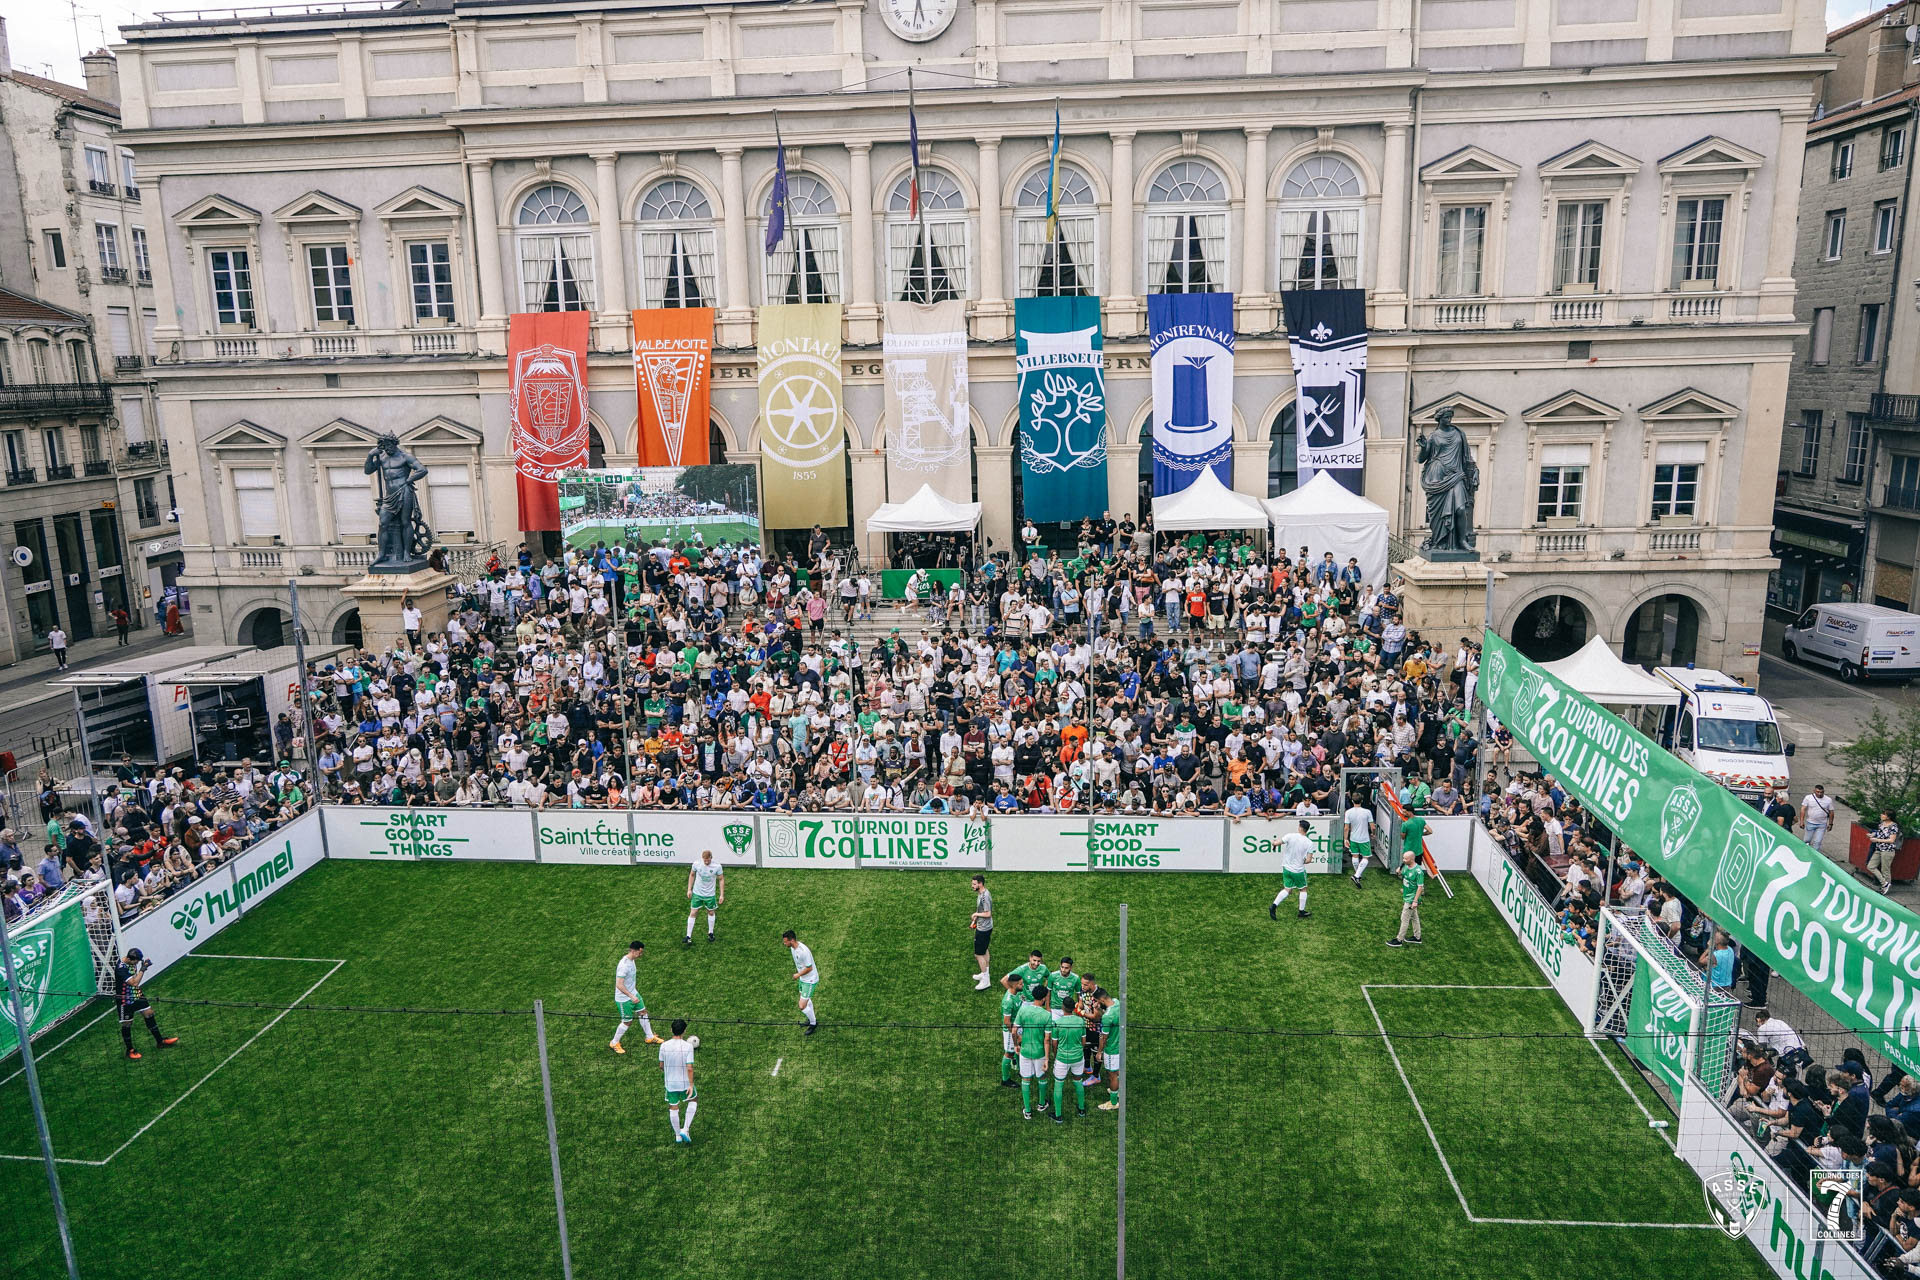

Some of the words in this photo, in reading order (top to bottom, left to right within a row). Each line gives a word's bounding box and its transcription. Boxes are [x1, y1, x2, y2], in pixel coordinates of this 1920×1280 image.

[793, 471, 817, 481] 1855
[920, 464, 940, 475] 1587
[1529, 682, 1560, 746] 7
[1561, 694, 1621, 755] TOURNOI
[1619, 734, 1649, 777] DES
[1538, 718, 1640, 822] COLLINES
[1670, 794, 1697, 820] ASSE
[389, 813, 447, 828] SMART
[385, 828, 435, 842] GOOD
[726, 827, 750, 835] ASSE
[964, 822, 994, 839] Vert
[1094, 823, 1159, 837] SMART
[799, 820, 823, 858] 7
[832, 820, 909, 835] TOURNOI
[915, 821, 948, 836] DES
[1087, 838, 1142, 851] GOOD
[389, 843, 453, 857] THINGS
[579, 847, 599, 857] Ville
[601, 847, 641, 858] créative
[643, 847, 676, 859] design
[819, 837, 949, 860] COLLINES
[1091, 854, 1160, 868] THINGS
[205, 840, 294, 925] hummel
[1502, 860, 1513, 905] 7
[1514, 873, 1547, 926] TOURNOI
[1754, 844, 1812, 943] 7
[1507, 888, 1562, 977] COLLINES
[1884, 1040, 1902, 1062] PAR
